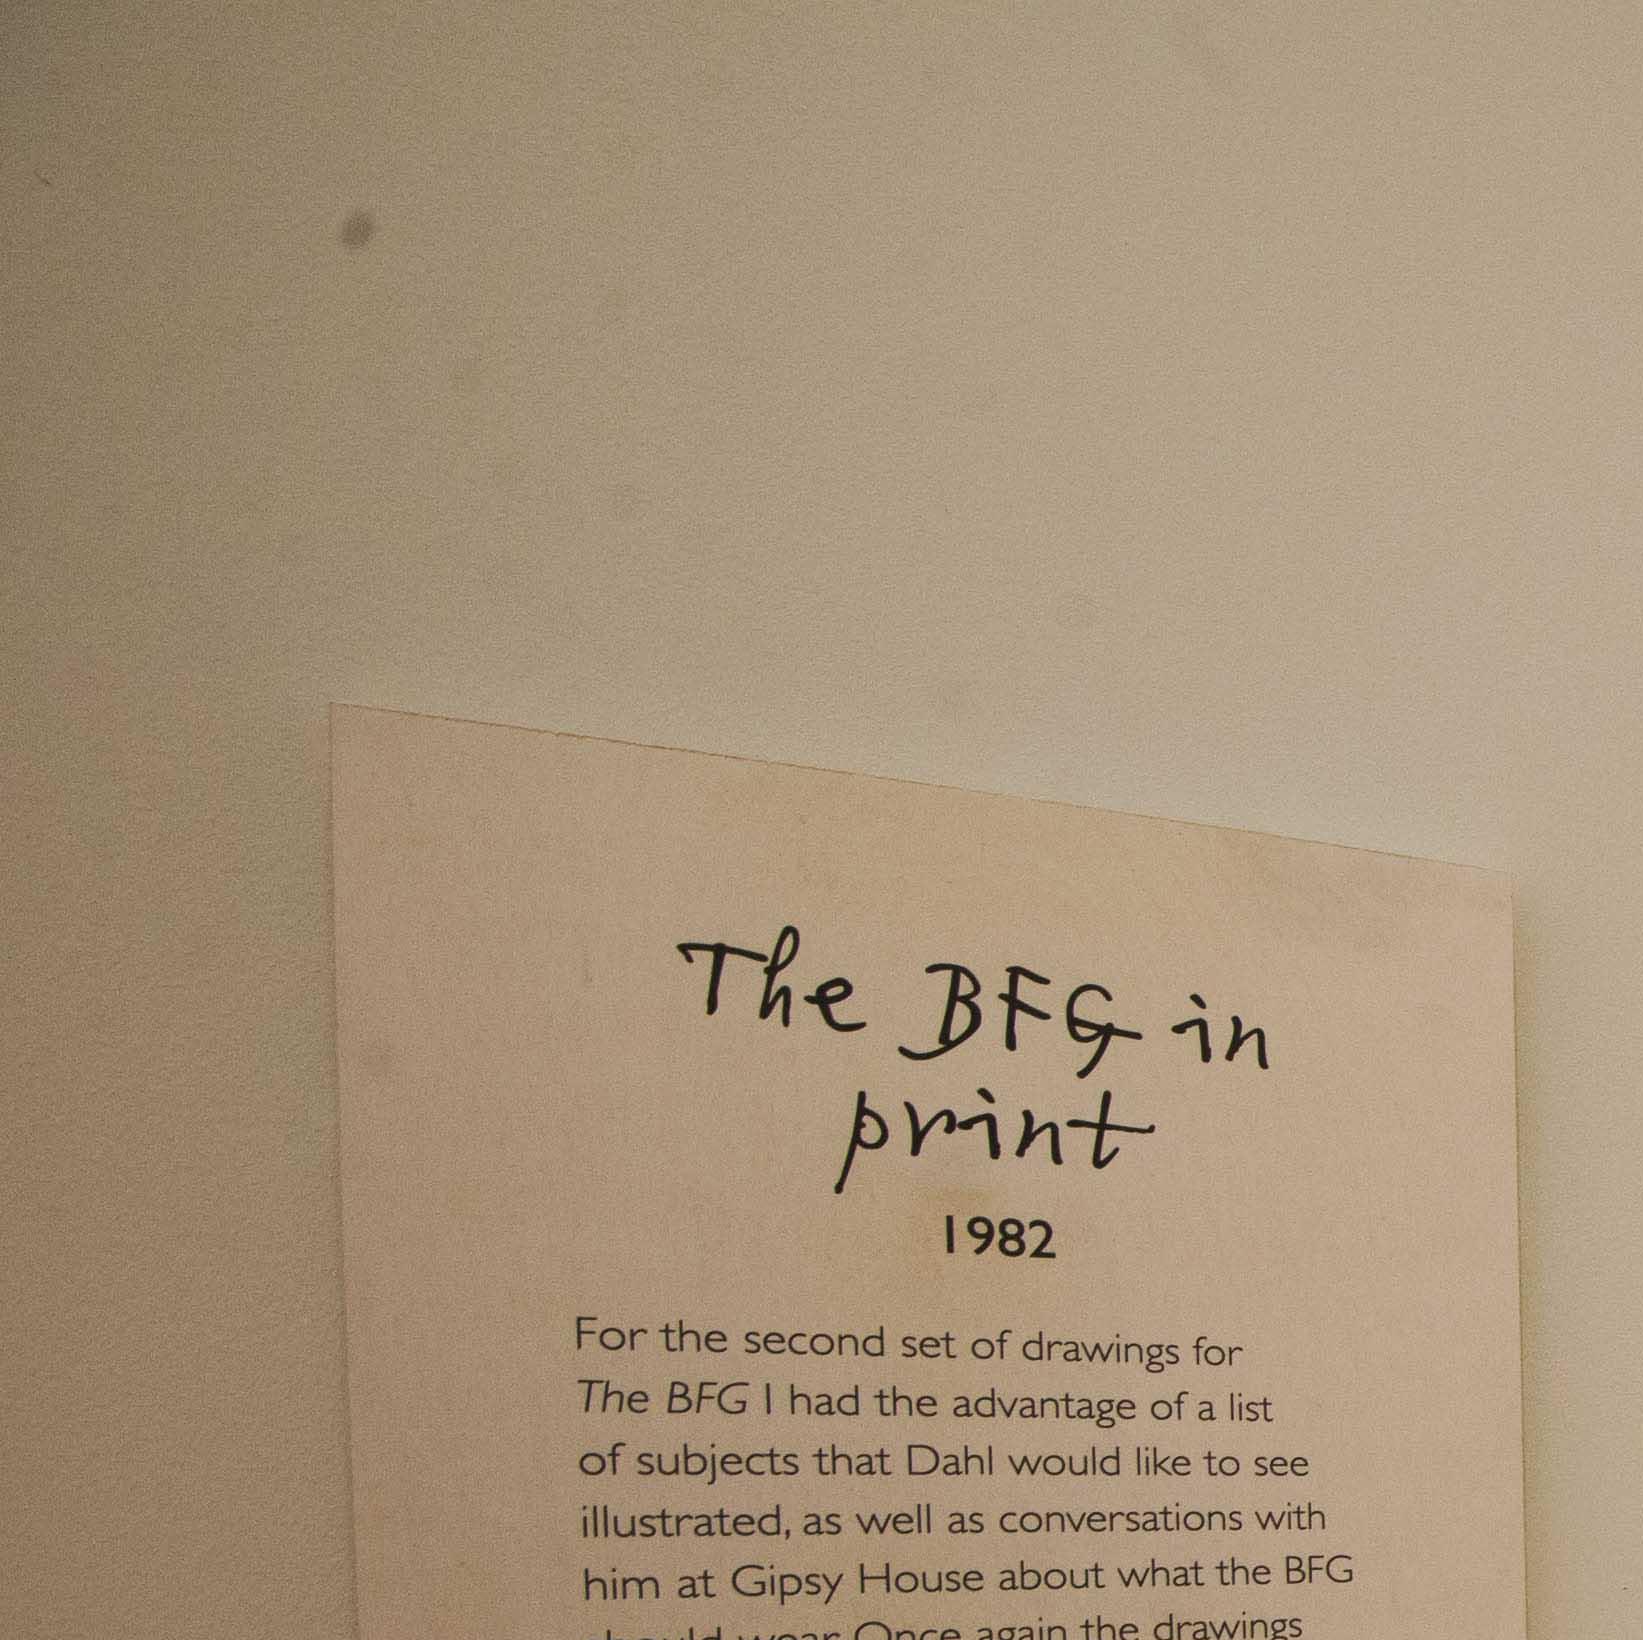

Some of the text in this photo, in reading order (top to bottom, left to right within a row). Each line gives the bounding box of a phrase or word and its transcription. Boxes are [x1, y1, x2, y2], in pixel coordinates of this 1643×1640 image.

[675, 924, 1270, 1080] The BFG in
[833, 1087, 1157, 1195] print
[945, 1214, 1057, 1260] 1982
[575, 1315, 1244, 1374] For the second set of drawings for
[576, 1379, 1274, 1429] The BFG I had the advantage of a list
[578, 1441, 1309, 1486] of subjects that Dahl would like to see
[581, 1501, 1326, 1541] illustrated, as well as conversations with
[583, 1554, 1354, 1606] him at Gipsy House about what the BFG
